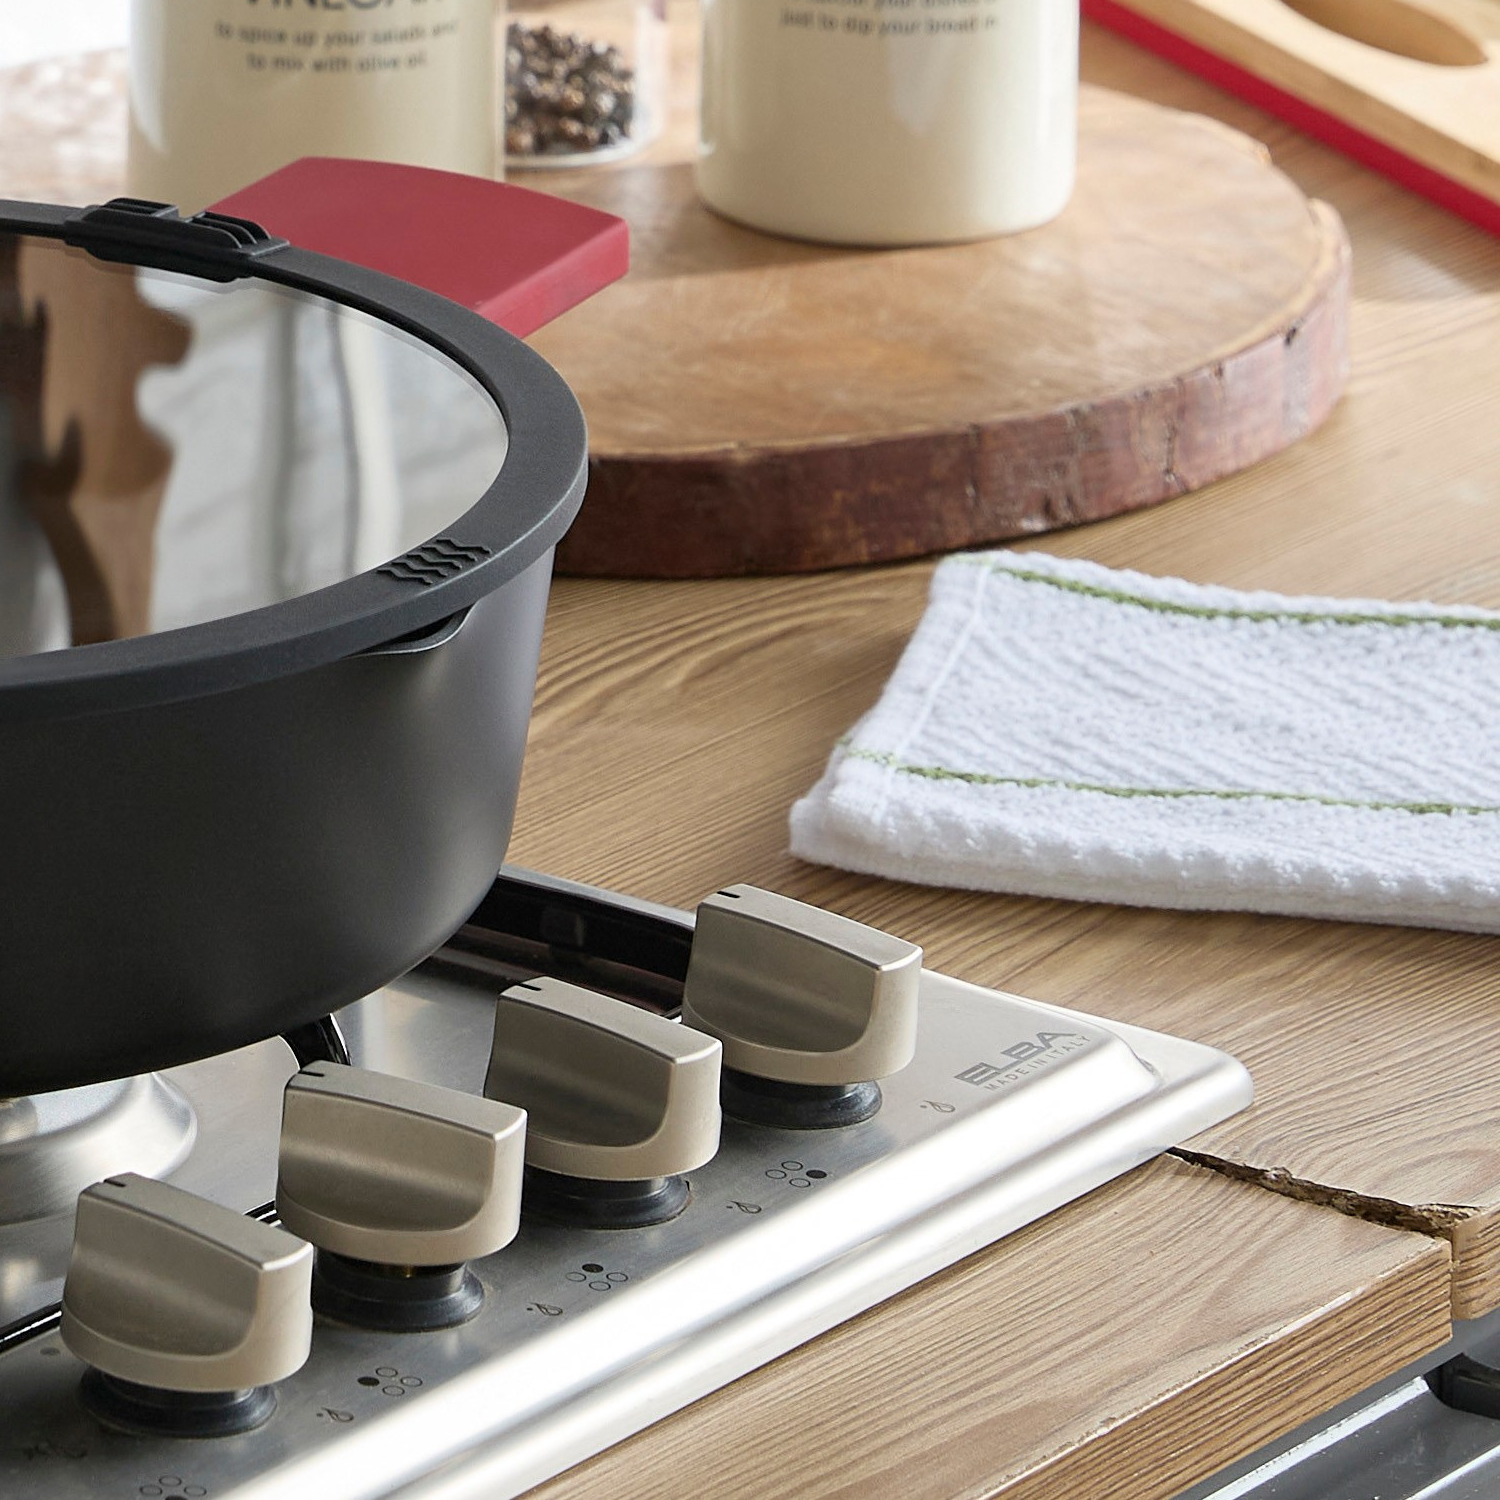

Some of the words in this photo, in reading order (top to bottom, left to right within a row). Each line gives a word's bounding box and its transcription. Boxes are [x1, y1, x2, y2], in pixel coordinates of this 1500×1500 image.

[311, 53, 351, 72] with
[954, 1031, 1077, 1086] ELBA
[986, 1067, 1030, 1090] MADE
[1027, 1058, 1049, 1070] IN
[1046, 1035, 1091, 1059] ITALY
